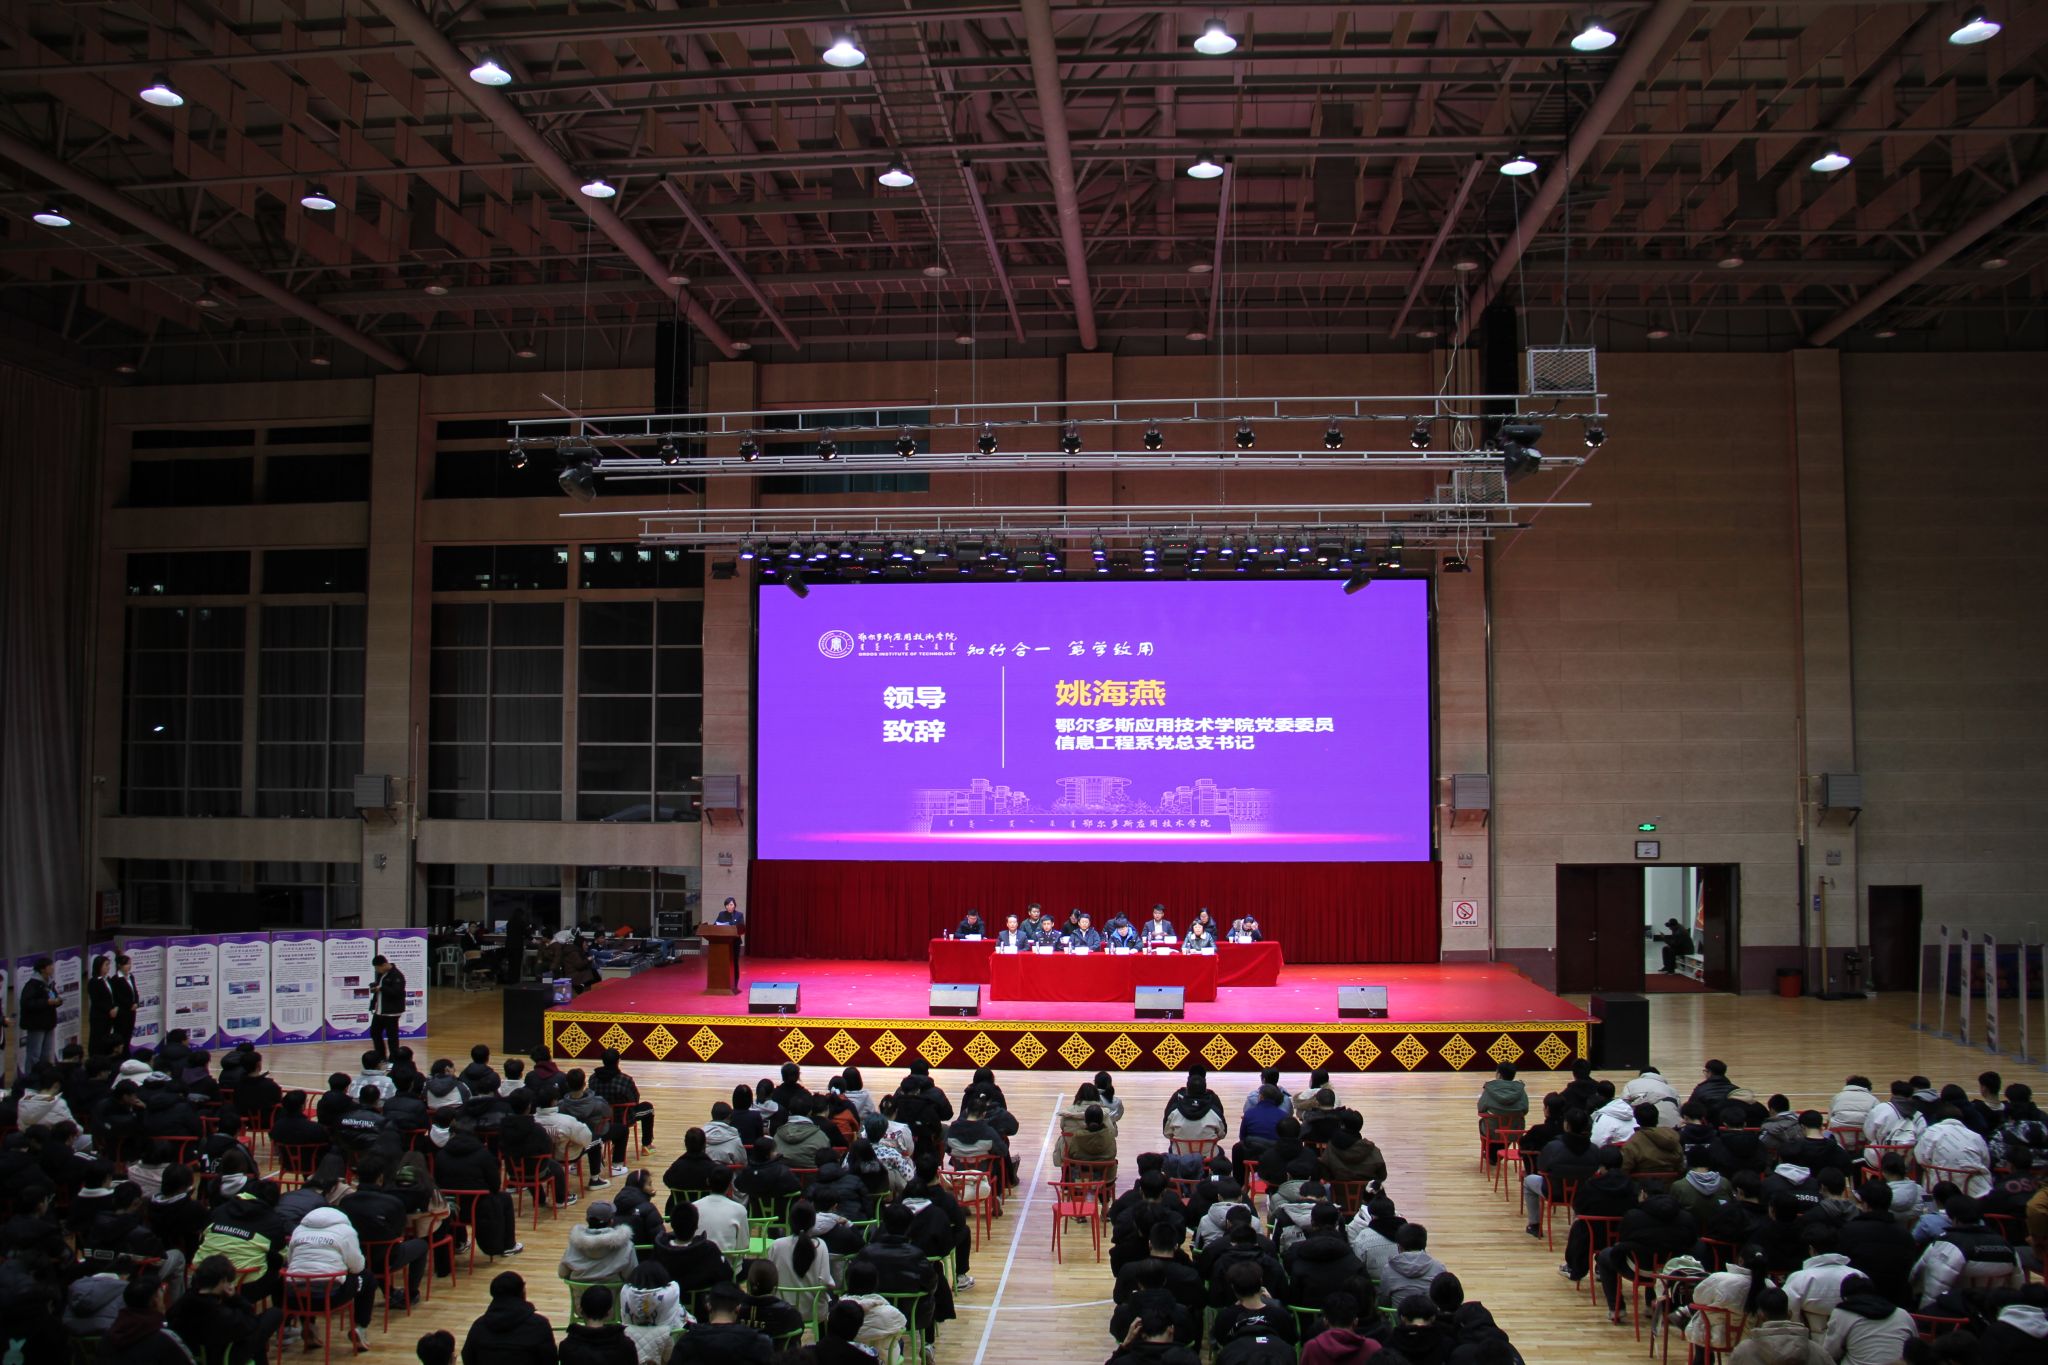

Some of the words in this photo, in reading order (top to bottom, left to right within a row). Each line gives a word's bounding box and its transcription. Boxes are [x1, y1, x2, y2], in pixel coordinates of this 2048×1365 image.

[966, 641, 1051, 658] 知行合一
[882, 685, 948, 711] 领导
[1054, 678, 1168, 709] 姚海燕
[882, 718, 948, 744] 致辞
[1055, 717, 1335, 734] 鄂尔多斯应用技术学院党委委员
[1055, 734, 1256, 752] 信息工程系党总支书记
[1081, 818, 1212, 829] 鄂尔多斯应用技术学院
